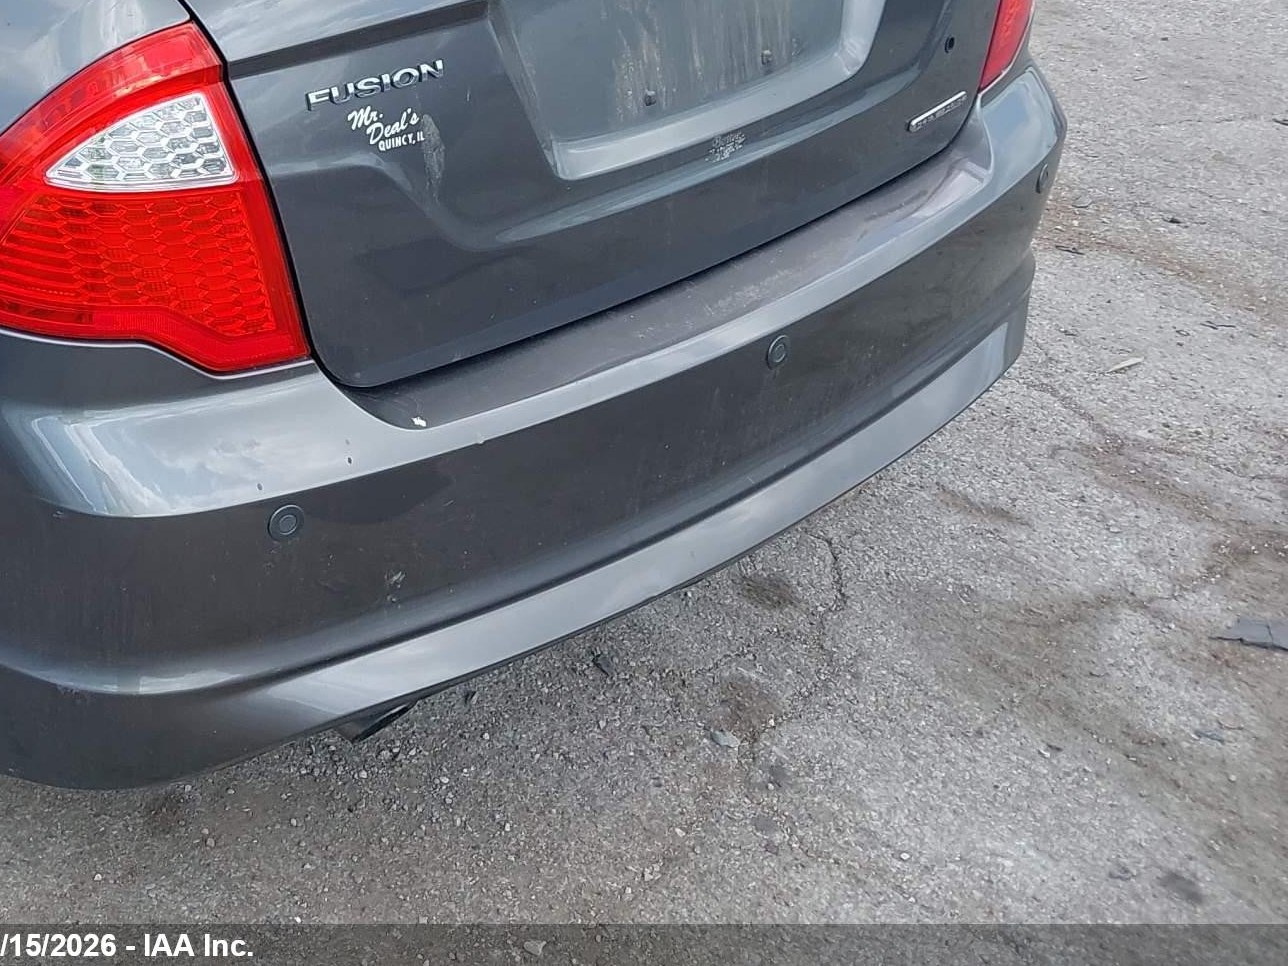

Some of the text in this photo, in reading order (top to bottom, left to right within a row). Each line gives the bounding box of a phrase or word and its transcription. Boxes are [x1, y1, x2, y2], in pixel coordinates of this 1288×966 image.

[306, 59, 444, 111] FUSION
[347, 106, 383, 130] Mr.
[366, 108, 419, 144] Deal's
[378, 131, 425, 151] QUINCY, IL
